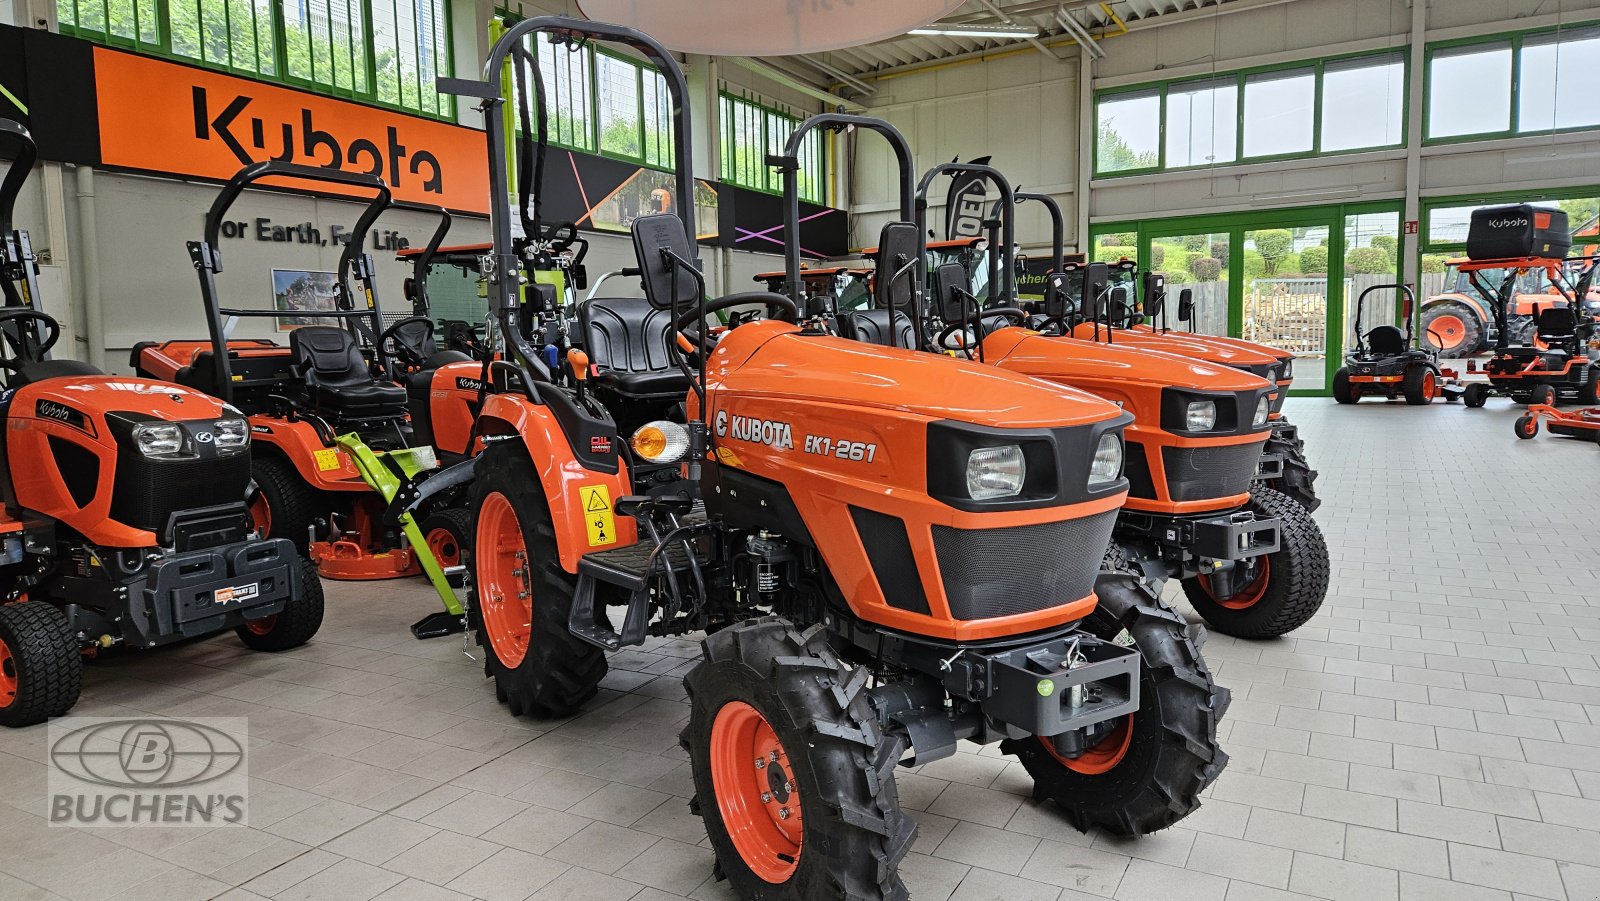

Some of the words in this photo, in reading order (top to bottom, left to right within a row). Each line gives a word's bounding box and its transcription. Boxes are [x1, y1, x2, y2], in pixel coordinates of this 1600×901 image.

[192, 86, 443, 194] Kubota
[206, 212, 248, 239] or
[256, 217, 328, 247] Earth,
[373, 228, 410, 250] Life
[1488, 217, 1528, 228] Kubota
[40, 400, 69, 420] Kubota
[591, 436, 611, 446] OIL
[731, 414, 795, 449] KUBOTA
[804, 434, 877, 463] EK1-261
